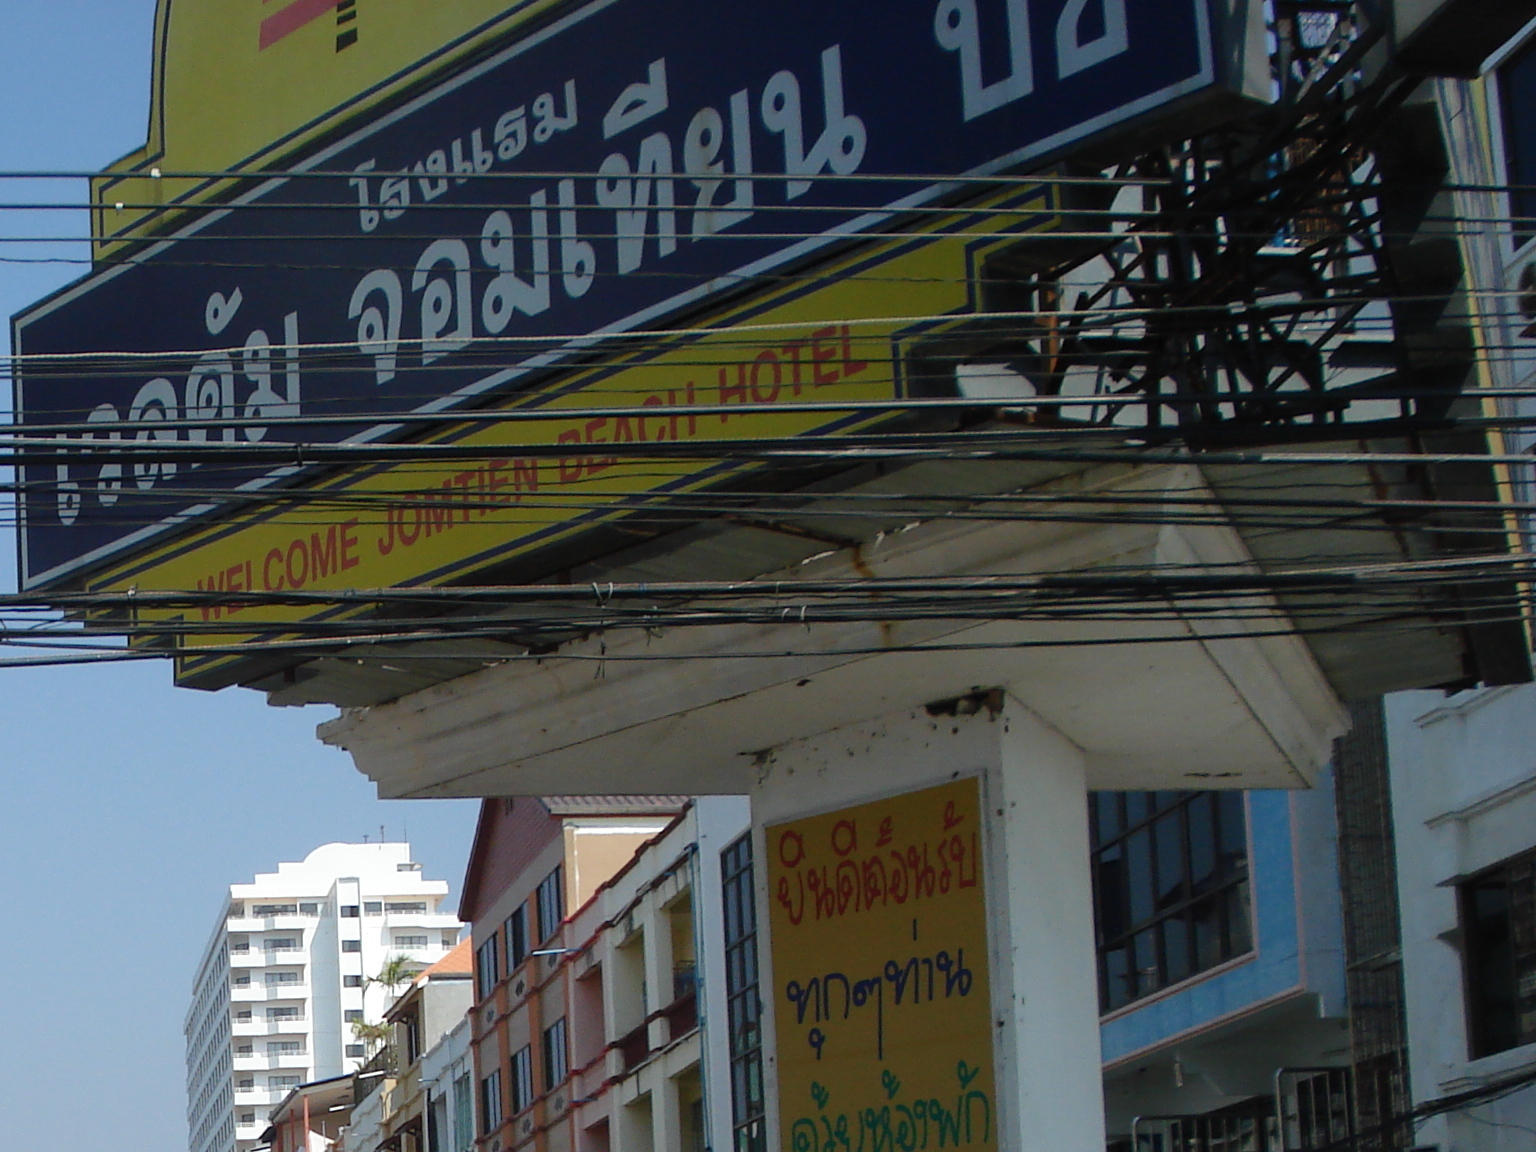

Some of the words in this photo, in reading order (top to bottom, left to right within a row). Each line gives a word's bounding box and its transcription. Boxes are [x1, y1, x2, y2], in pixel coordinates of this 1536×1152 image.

[348, 44, 867, 385] จอมเทียน
[349, 78, 578, 233] โรงแรม
[197, 517, 360, 623] WELCOME
[378, 451, 539, 557] JOMTIEN
[558, 381, 696, 485] BEACH
[718, 323, 868, 424] HOTEL
